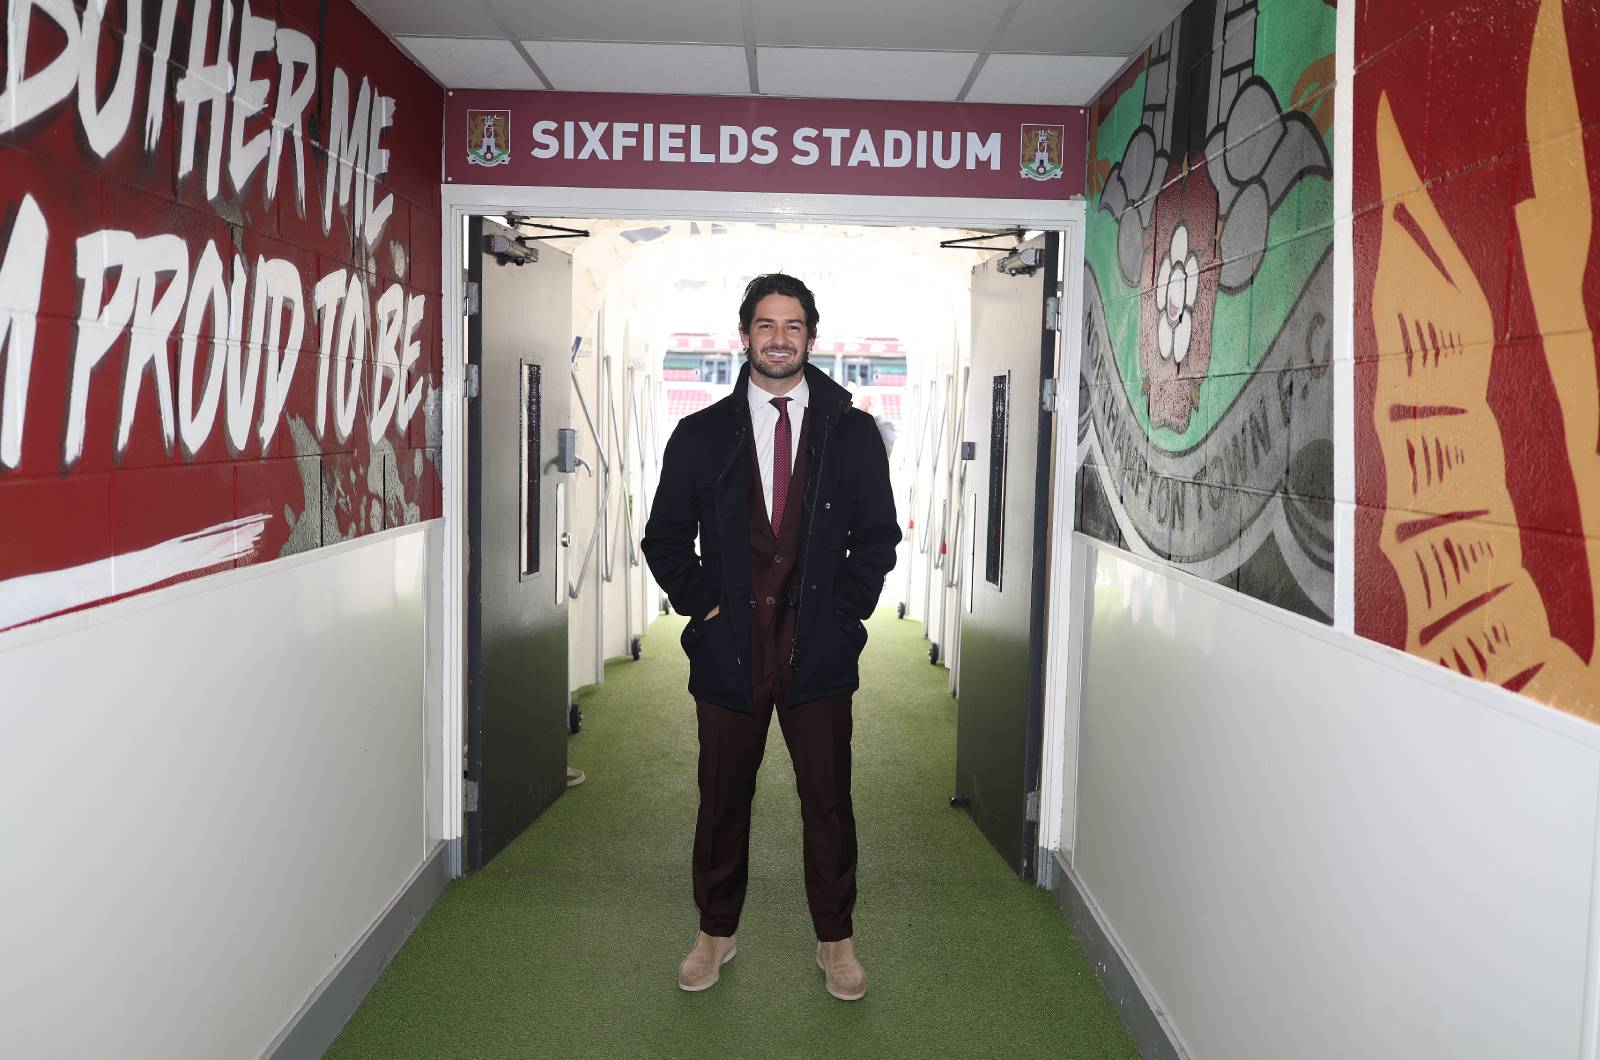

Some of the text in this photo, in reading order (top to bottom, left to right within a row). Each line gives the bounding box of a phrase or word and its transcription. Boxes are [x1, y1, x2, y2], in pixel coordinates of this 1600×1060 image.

[322, 68, 396, 245] ME
[530, 119, 1001, 171] SIXFIELDS STADIUM
[65, 230, 304, 466] PROUD
[315, 268, 366, 445] TO
[369, 281, 425, 446] BE
[1192, 397, 1271, 521] TOWN
